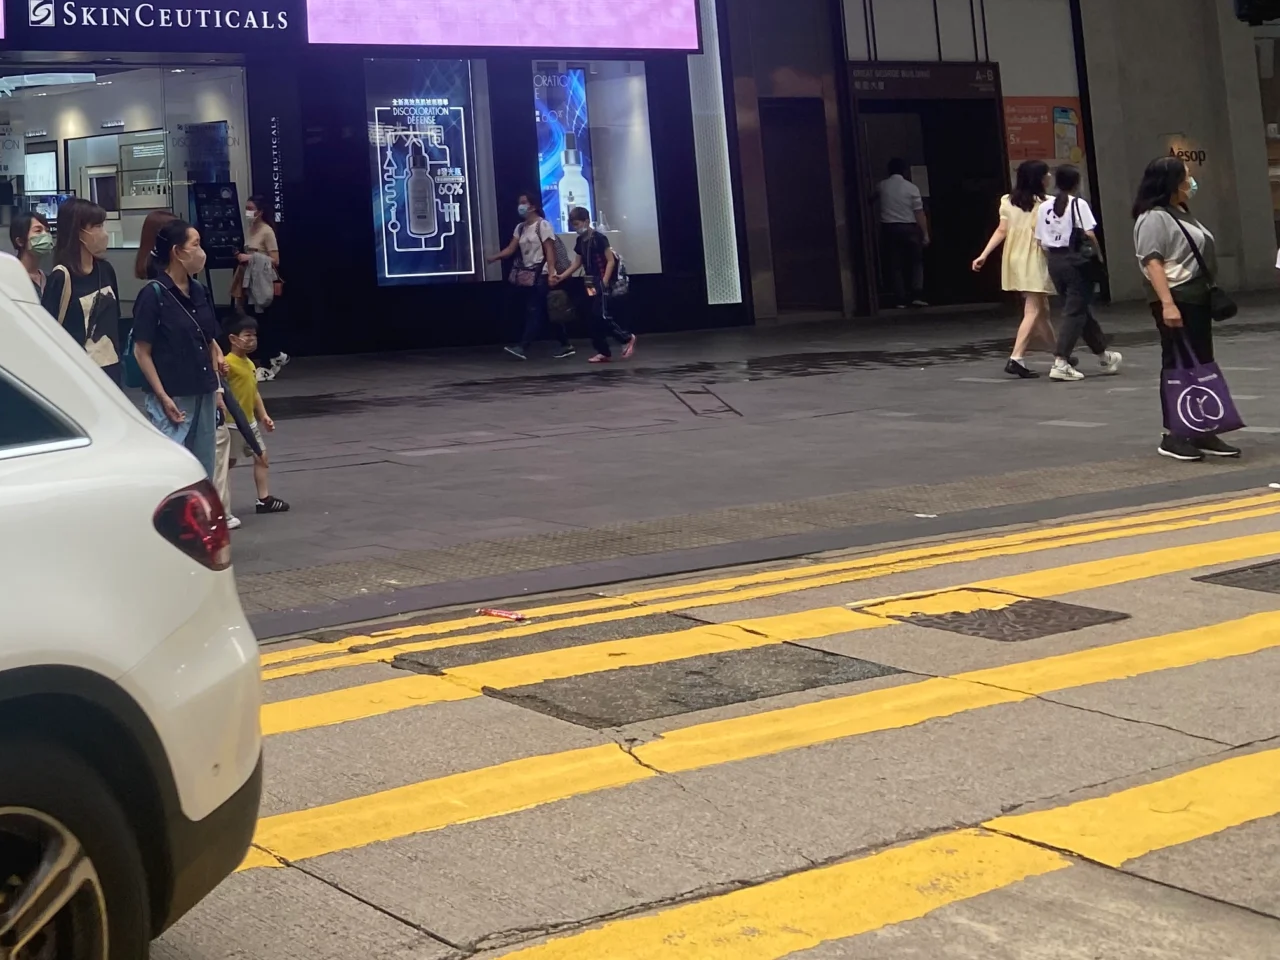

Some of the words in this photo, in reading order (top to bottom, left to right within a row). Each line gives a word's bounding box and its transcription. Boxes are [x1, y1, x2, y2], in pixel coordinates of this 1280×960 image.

[975, 69, 995, 81] A-B
[393, 106, 449, 116] DISCOLORATION
[407, 116, 436, 125] DEFENSE
[438, 182, 464, 195] 60%
